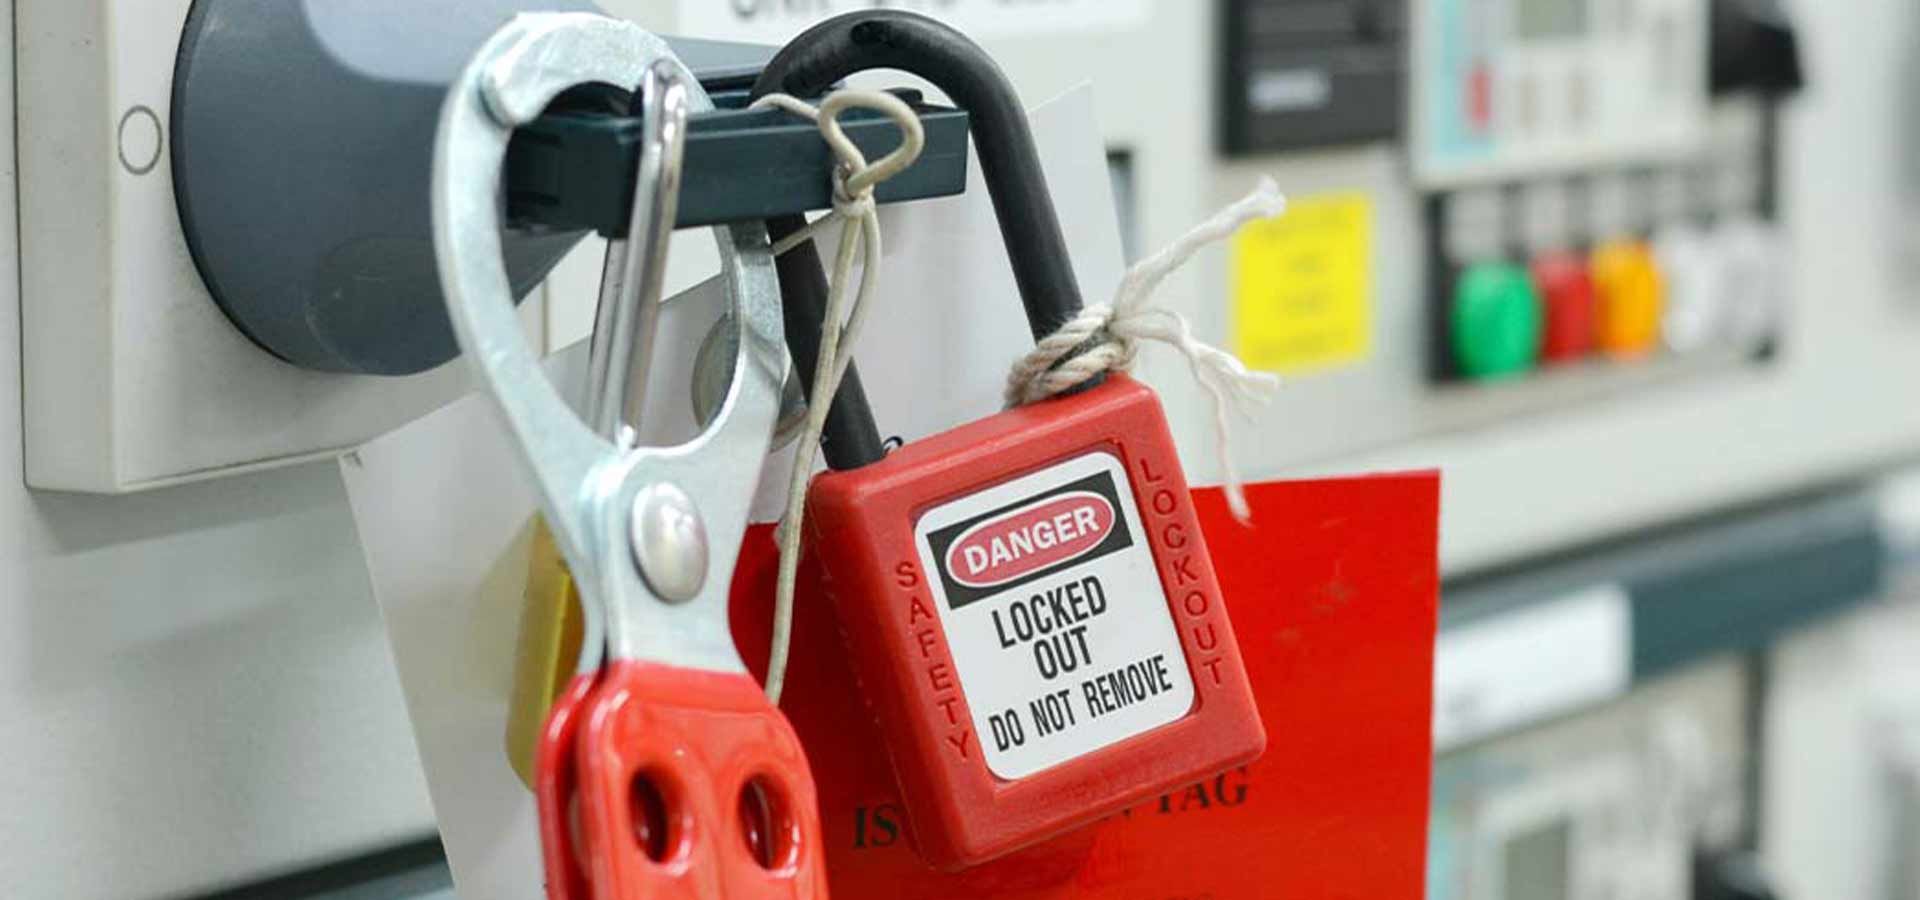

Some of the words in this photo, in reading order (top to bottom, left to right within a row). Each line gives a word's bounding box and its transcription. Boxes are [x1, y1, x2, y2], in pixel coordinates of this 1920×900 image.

[962, 504, 1101, 577] DANGER
[1140, 458, 1222, 686] LOCKOUT
[991, 575, 1108, 650] LOCKED
[1033, 625, 1092, 681] OUT
[895, 561, 969, 758] SAFETY
[988, 708, 1025, 753] DO
[1029, 689, 1077, 738] NOT
[1081, 654, 1173, 719] REMOVE
